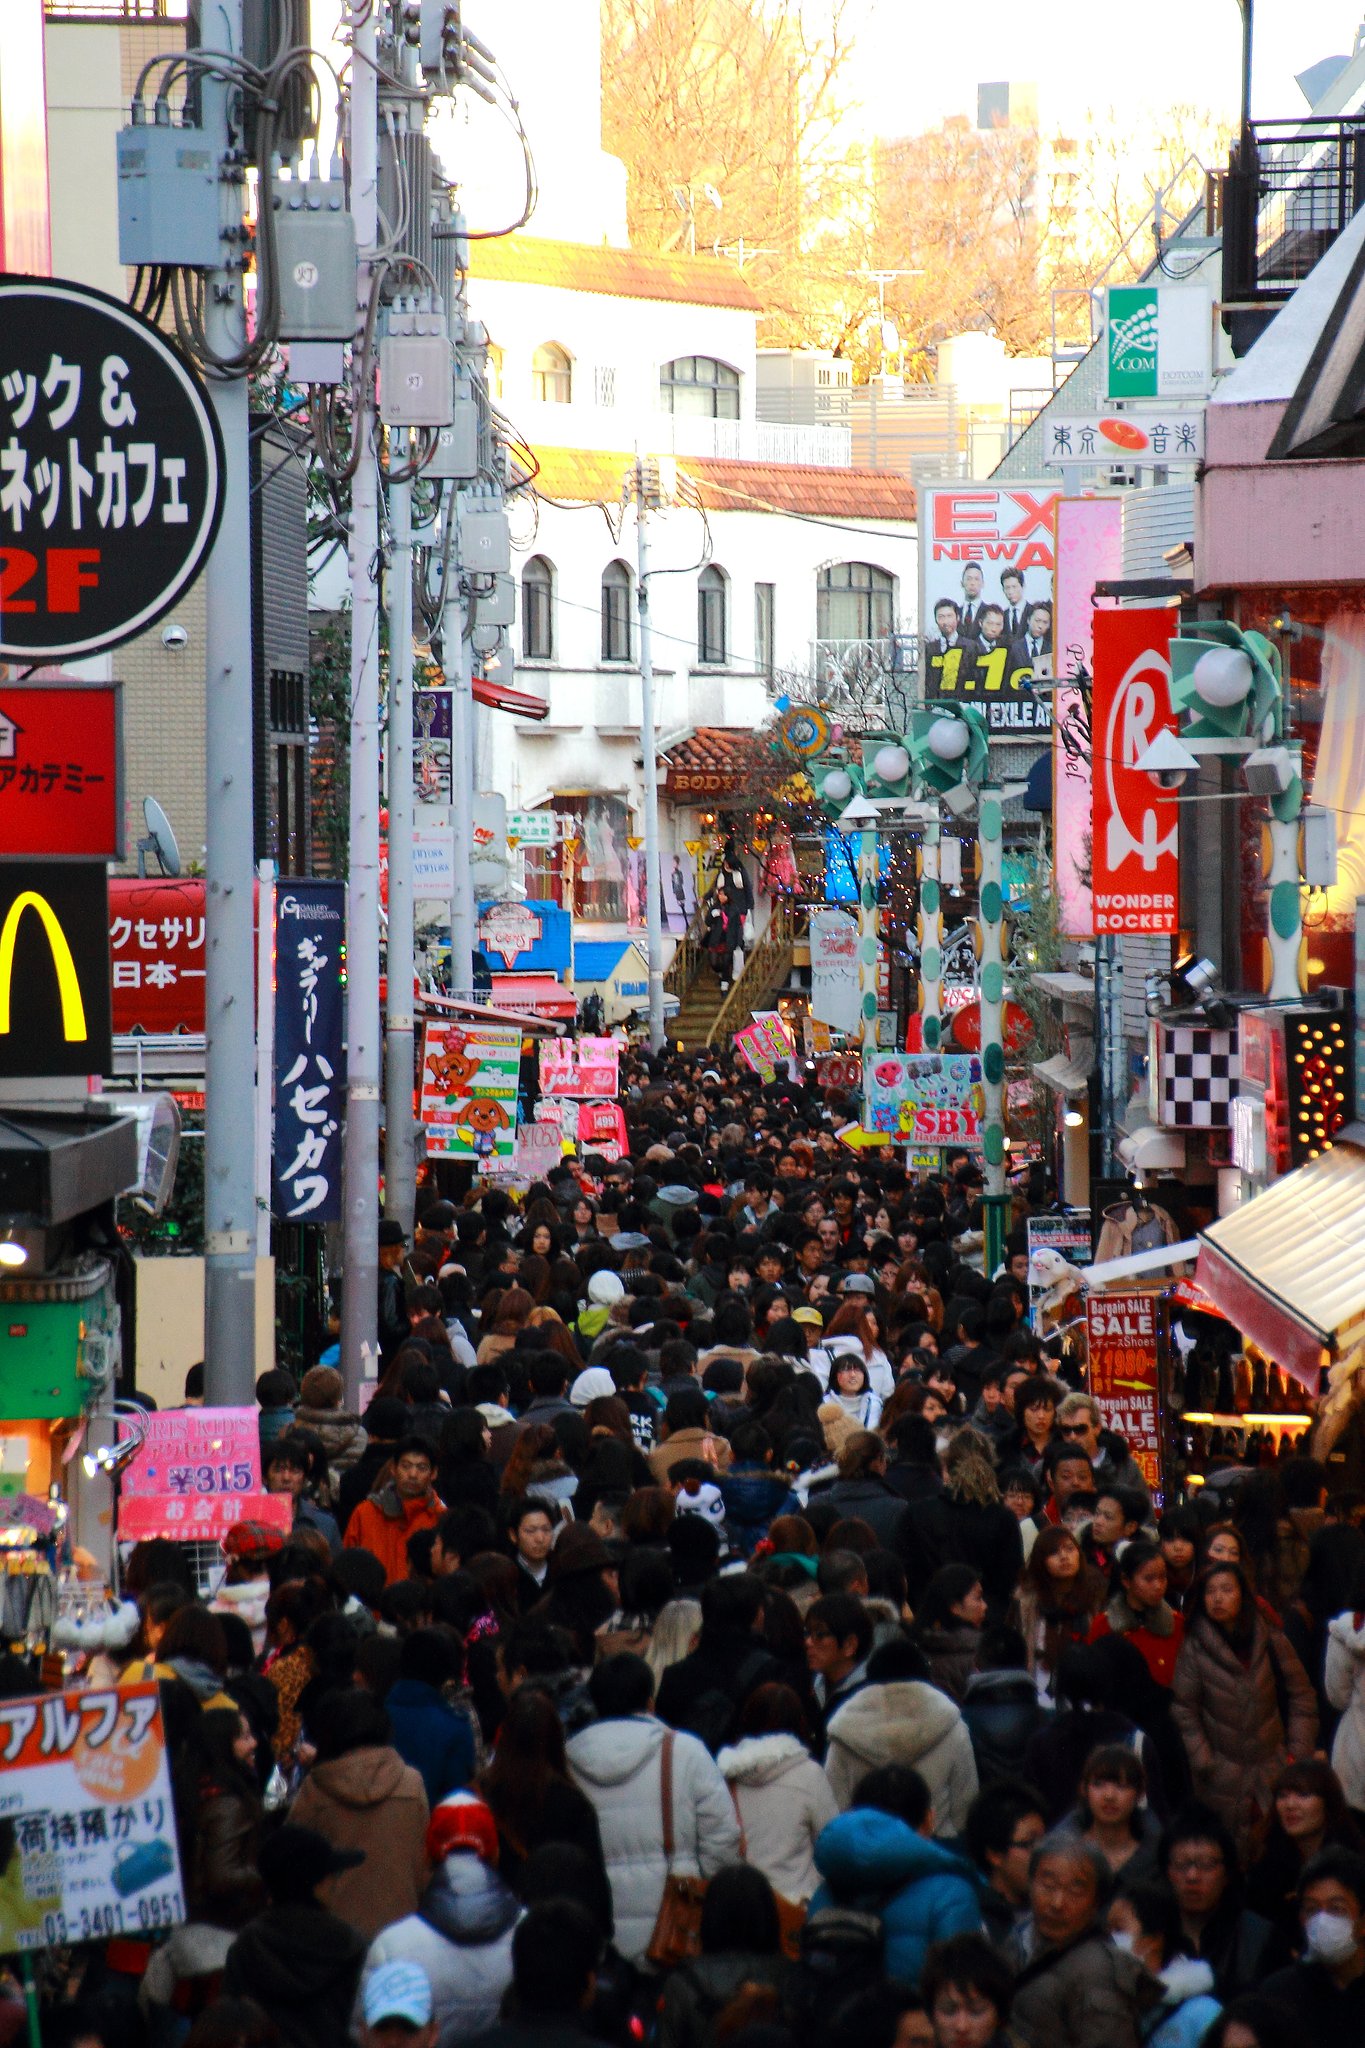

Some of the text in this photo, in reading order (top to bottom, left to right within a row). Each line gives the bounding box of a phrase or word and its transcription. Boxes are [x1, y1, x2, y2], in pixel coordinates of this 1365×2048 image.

[1116, 356, 1155, 371] .COM
[101, 354, 137, 427] &
[1052, 422, 1197, 455] 東京 音楽
[0, 435, 189, 532] ネットカフェ
[932, 542, 1018, 561] NEW
[0, 547, 102, 614] 2F
[991, 702, 1034, 727] EXILE
[0, 764, 106, 794] アカデミー
[673, 775, 737, 791] BODY
[1096, 894, 1175, 910] WONDER
[1096, 913, 1175, 929] ROCKET
[915, 1109, 979, 1136] SBY
[279, 1053, 338, 1217] ハセガワ
[914, 1133, 948, 1143] Happy
[912, 1154, 939, 1167] SALE
[1091, 1299, 1151, 1317] Bargain SALE
[1091, 1316, 1153, 1336] SALE
[1094, 1396, 1153, 1414] Bargain SALE
[169, 1461, 254, 1494] ¥315
[165, 1498, 243, 1521] お会計
[0, 1692, 159, 1761] アルファ
